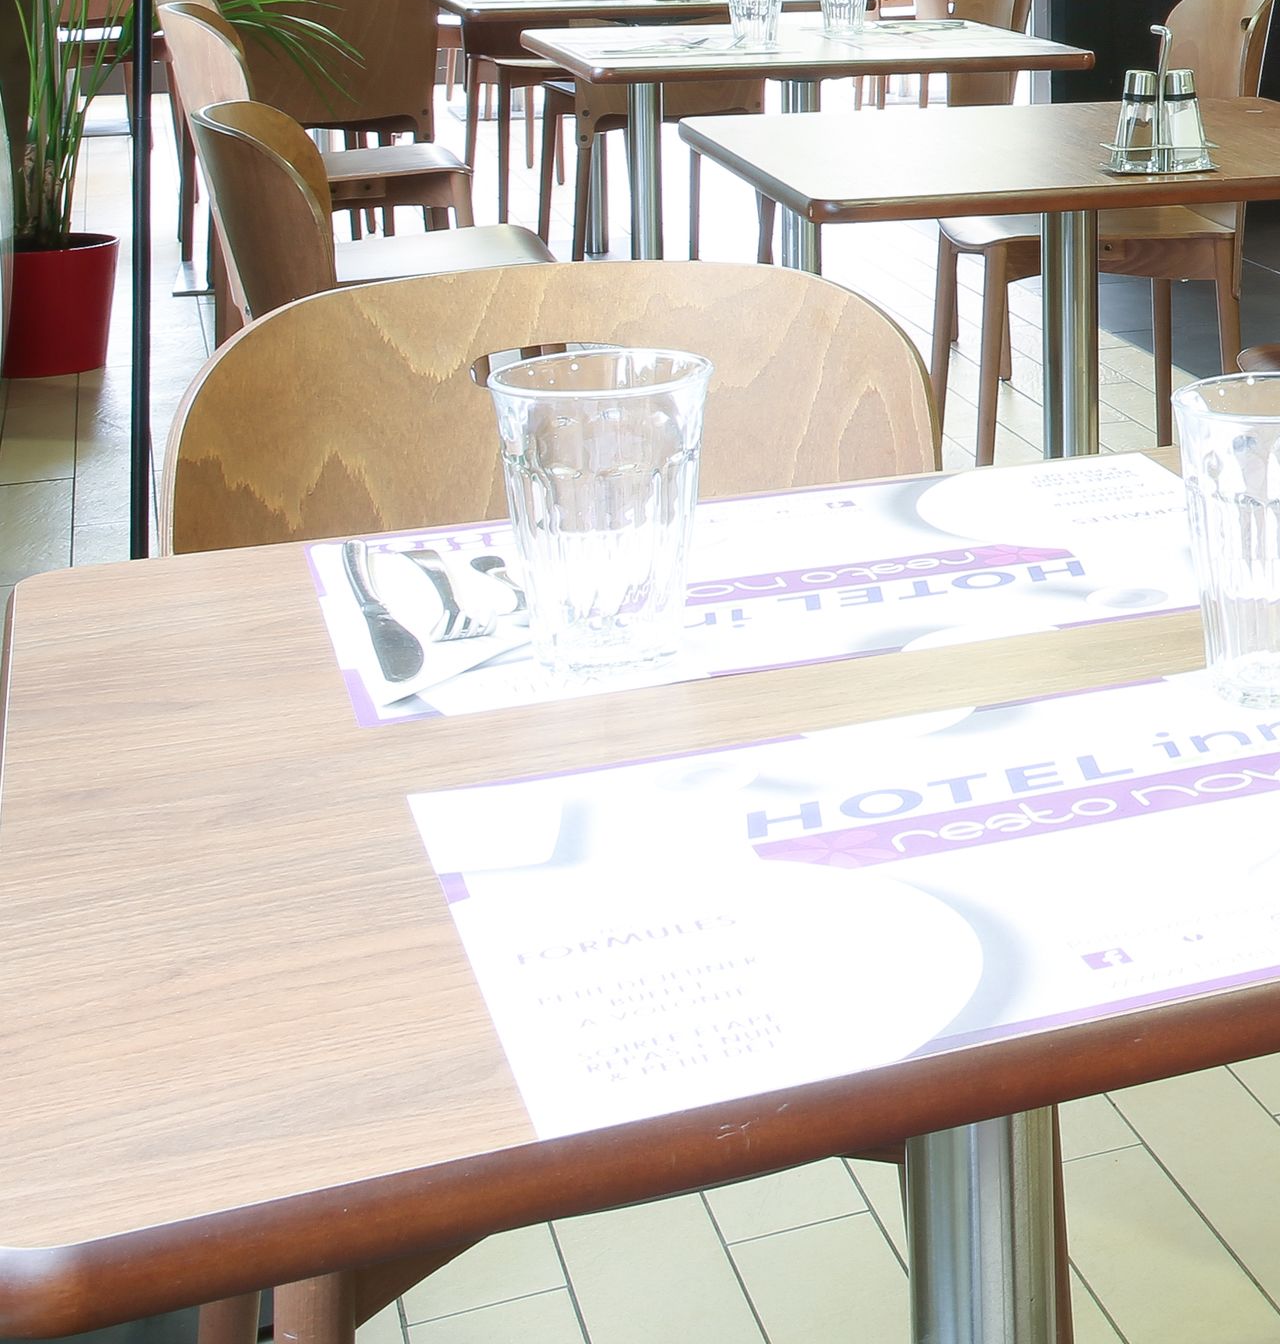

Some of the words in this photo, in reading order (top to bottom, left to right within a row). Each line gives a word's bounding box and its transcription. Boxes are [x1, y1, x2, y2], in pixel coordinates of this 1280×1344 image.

[776, 560, 1086, 612] HOTEL
[799, 552, 978, 585] resto
[747, 754, 1135, 839] HOTEL
[891, 797, 1117, 854] resto
[516, 915, 737, 965] FORMULES
